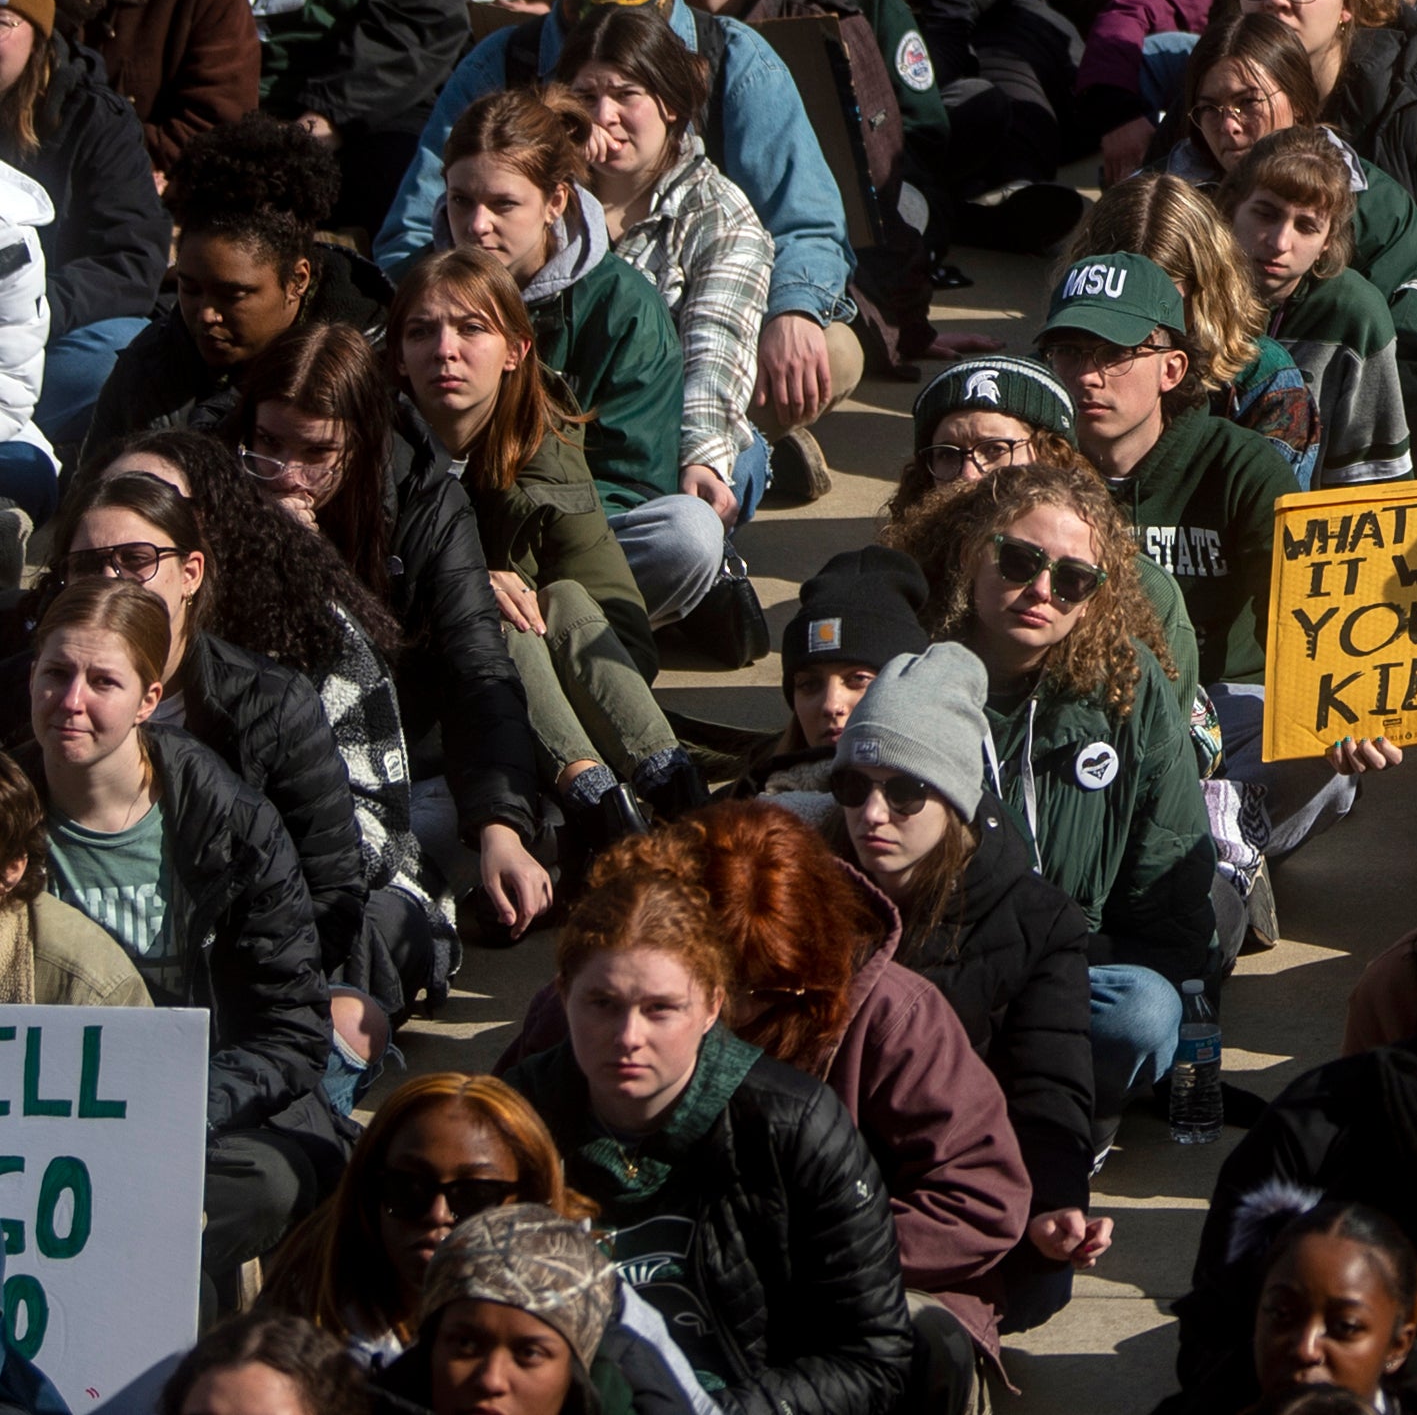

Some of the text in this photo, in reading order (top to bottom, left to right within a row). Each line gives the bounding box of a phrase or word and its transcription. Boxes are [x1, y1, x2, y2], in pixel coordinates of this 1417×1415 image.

[1062, 264, 1127, 300] MSU
[1145, 525, 1228, 578] STATE
[1304, 557, 1367, 599] IT
[0, 1025, 127, 1119] LL
